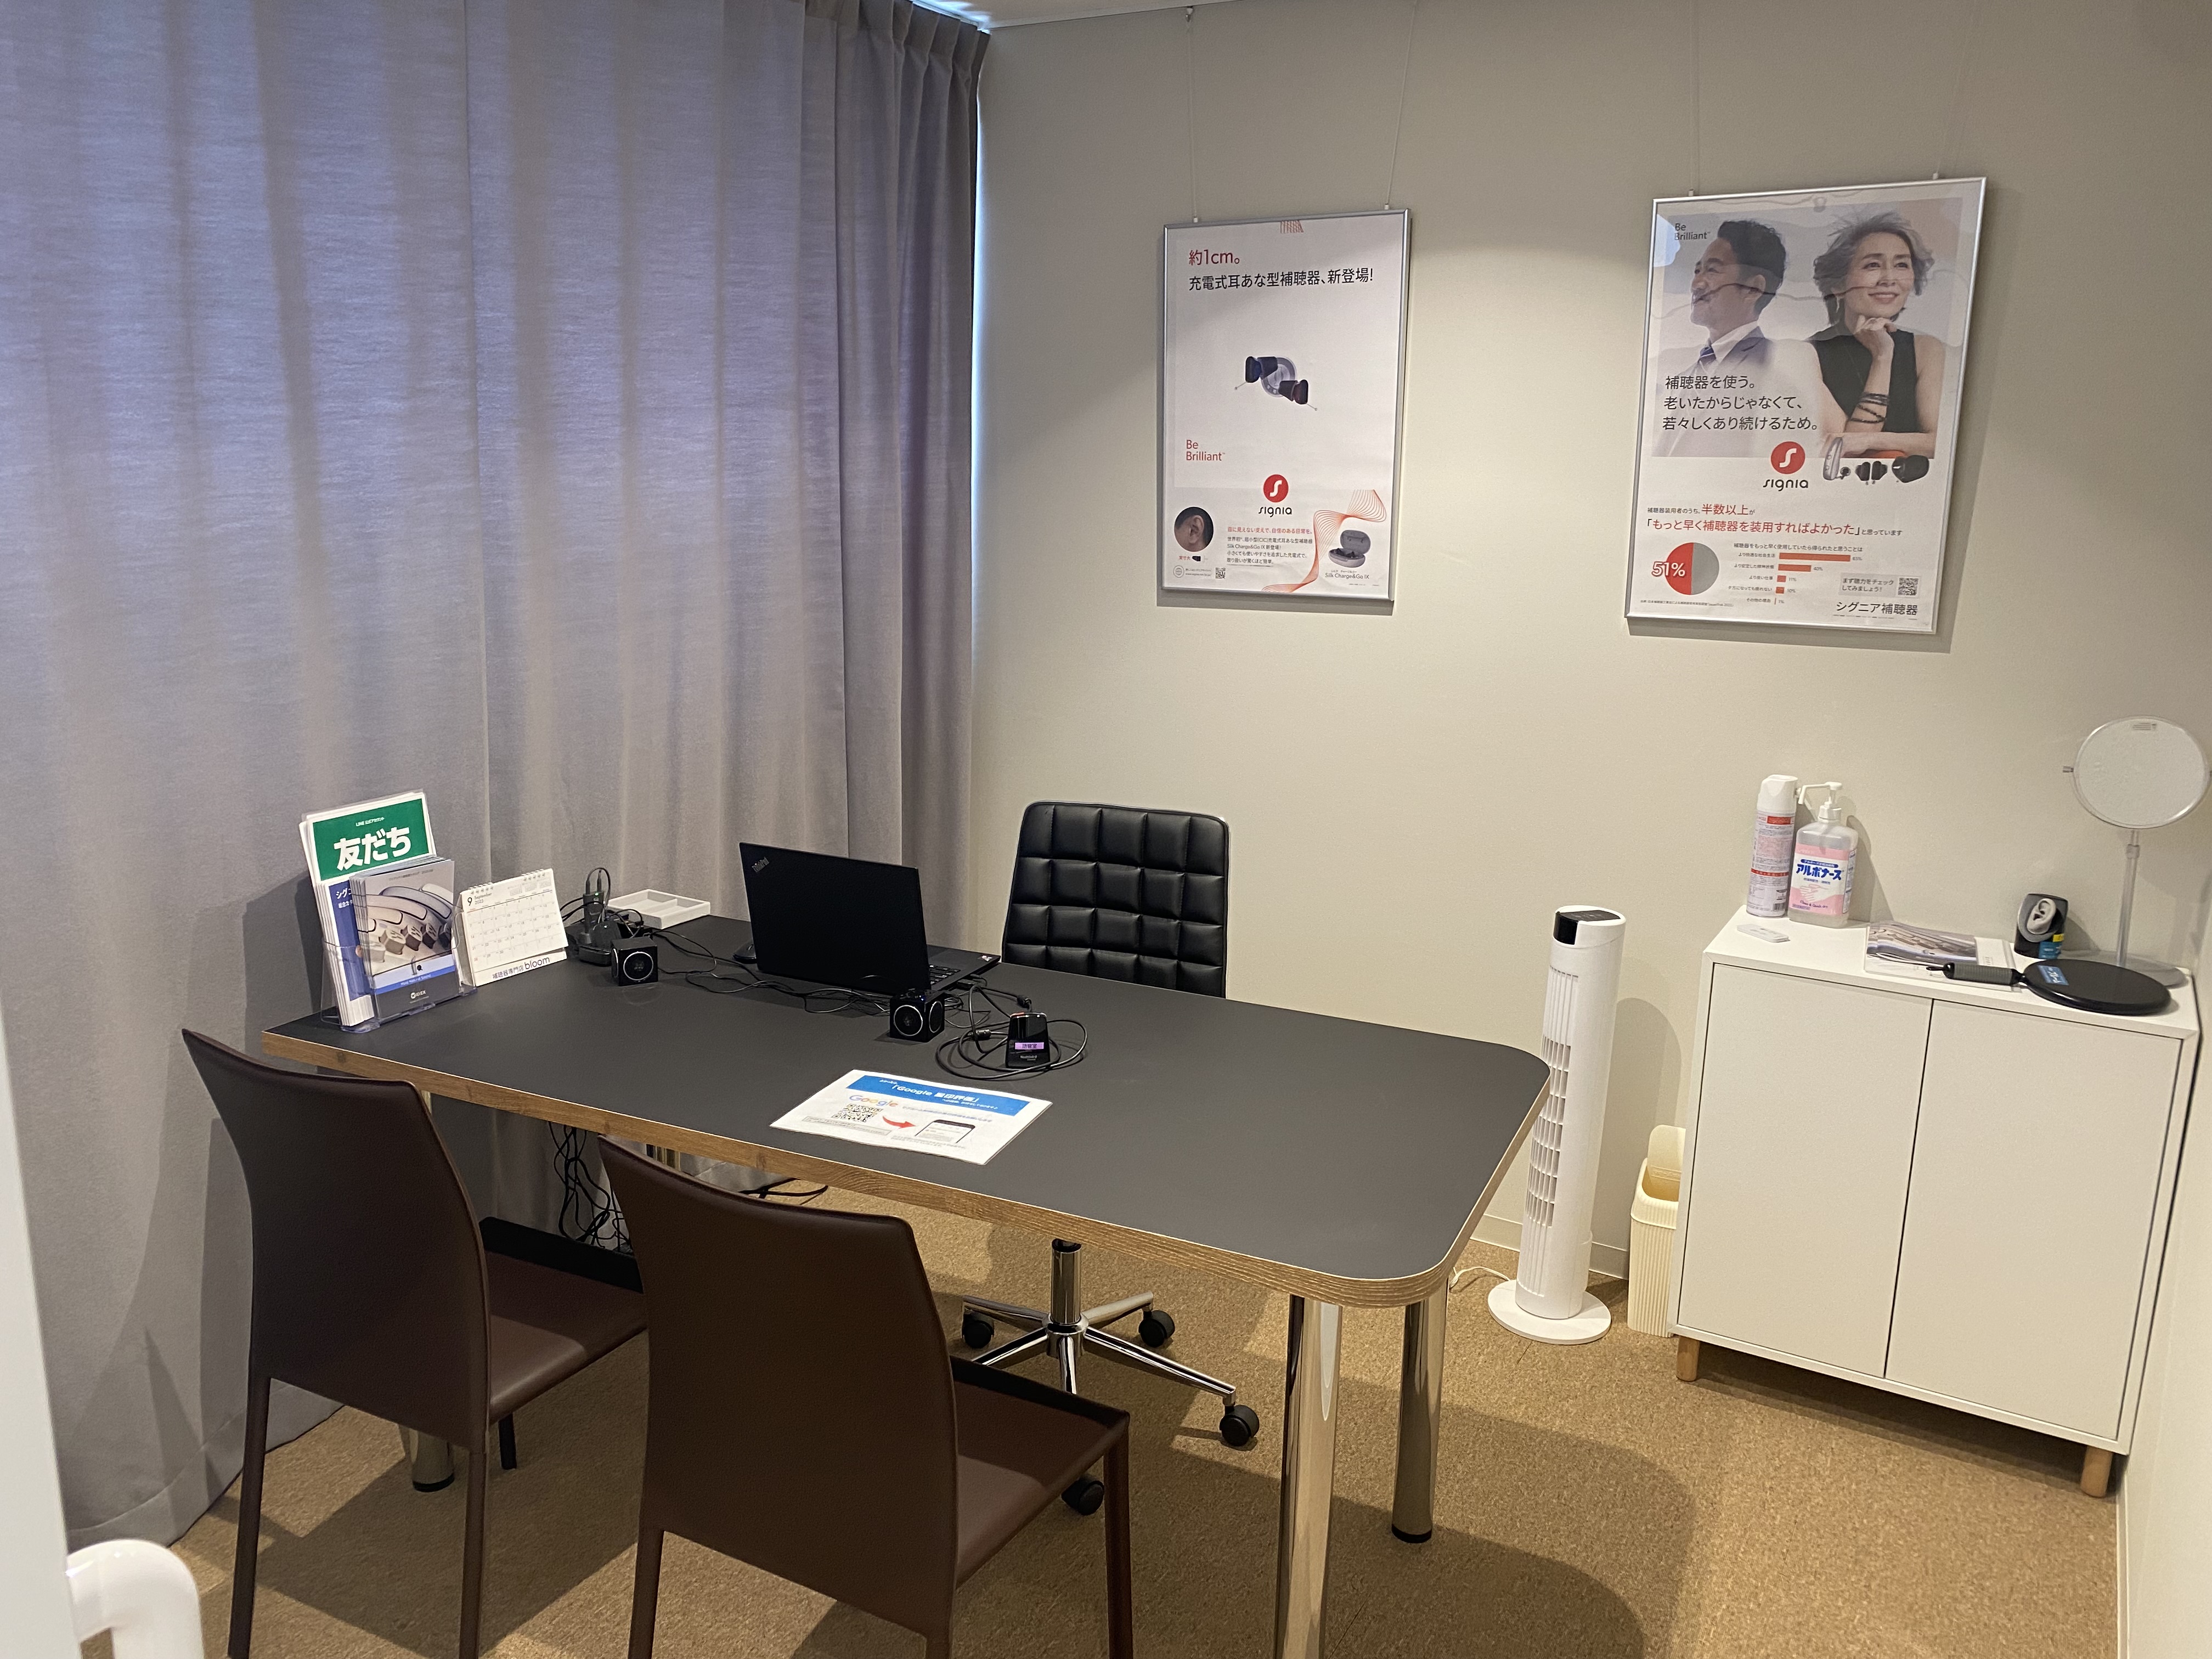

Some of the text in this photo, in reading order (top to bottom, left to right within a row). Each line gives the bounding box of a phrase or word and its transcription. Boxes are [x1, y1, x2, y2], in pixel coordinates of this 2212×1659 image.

[1675, 223, 1686, 231] Be
[1189, 249, 1240, 266] 約1cm。
[1665, 375, 1755, 390] 補聴器を使う。
[1664, 396, 1802, 410] 老いたからじゃなくて、
[1662, 416, 1818, 430] 若々しくあり続けるため。
[1186, 439, 1199, 449] Be
[1763, 479, 1809, 491] signia
[1259, 506, 1292, 517] signia
[1651, 561, 1686, 577] 51%
[1836, 601, 1918, 616] シグニア補聴器
[334, 827, 411, 871] 友だち
[1796, 864, 1842, 881] アルボナース
[467, 897, 472, 906] 9
[524, 957, 550, 969] bloom
[849, 1095, 899, 1107] Google
